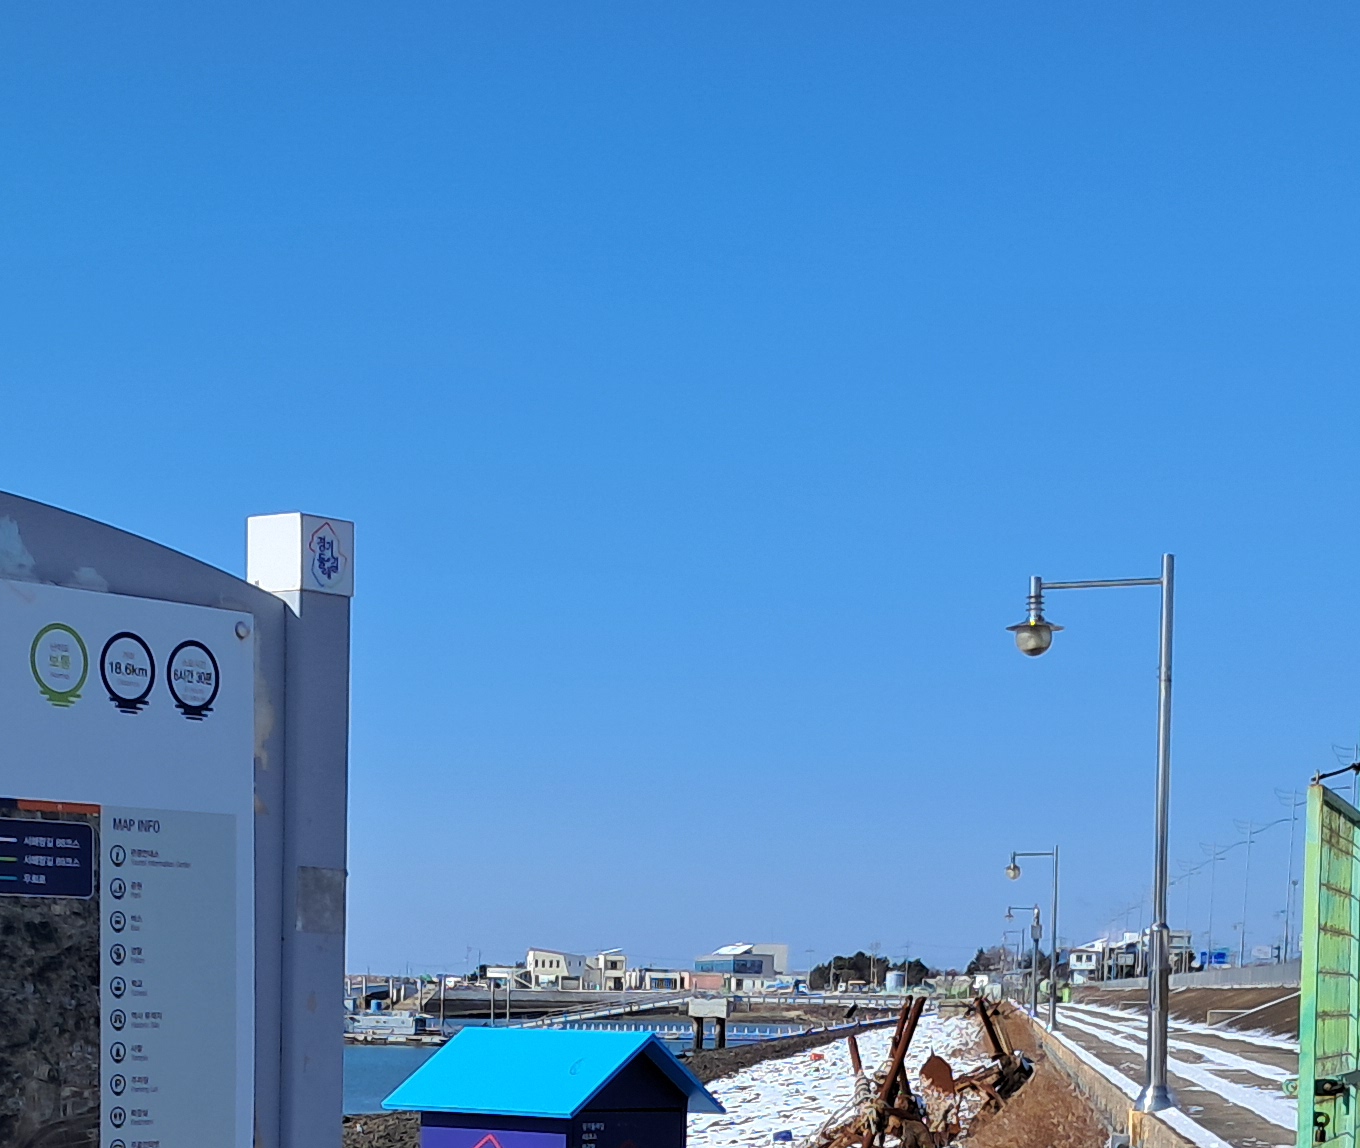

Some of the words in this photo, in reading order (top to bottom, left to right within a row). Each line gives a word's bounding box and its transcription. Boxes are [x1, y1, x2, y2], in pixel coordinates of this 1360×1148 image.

[108, 661, 148, 678] 18.6km
[113, 817, 135, 832] MAP
[138, 820, 160, 834] INFO
